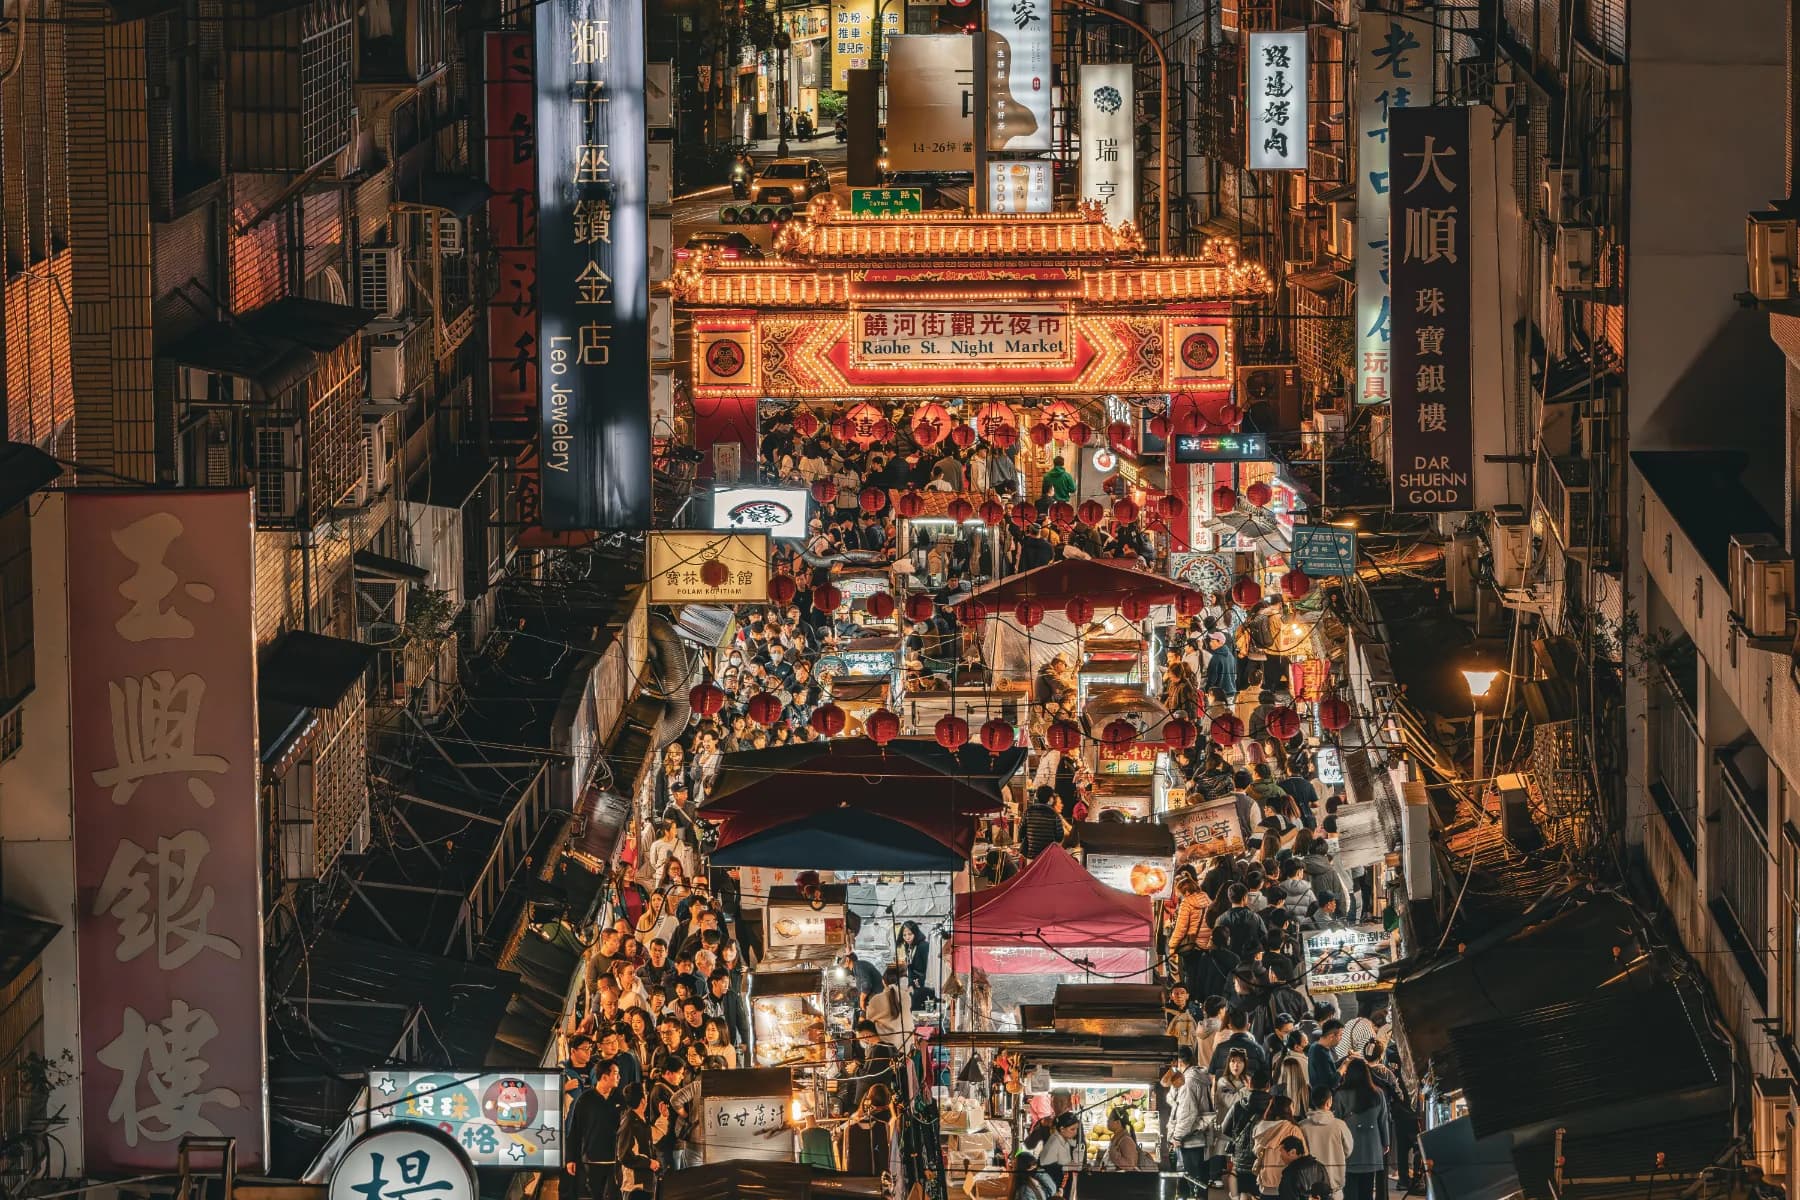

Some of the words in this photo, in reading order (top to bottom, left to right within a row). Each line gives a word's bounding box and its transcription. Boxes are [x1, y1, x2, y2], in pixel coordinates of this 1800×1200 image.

[838, 12, 899, 24] 奶粉、布
[863, 312, 1061, 337] 饒河街觀光夜市
[550, 335, 572, 375] Leo
[862, 340, 911, 355] Raohe
[921, 340, 941, 354] St.
[951, 340, 994, 357] Night
[1005, 338, 1064, 353] Market
[1414, 287, 1448, 433] 珠寶銀樓
[1363, 352, 1388, 399] 玩具
[547, 382, 574, 473] Jewelery
[1414, 456, 1450, 470] DAR
[1399, 473, 1467, 488] SHUENN
[1409, 489, 1458, 504] GOLD
[665, 570, 753, 586] 寶林館
[92, 510, 244, 1149] 玉興銀樓
